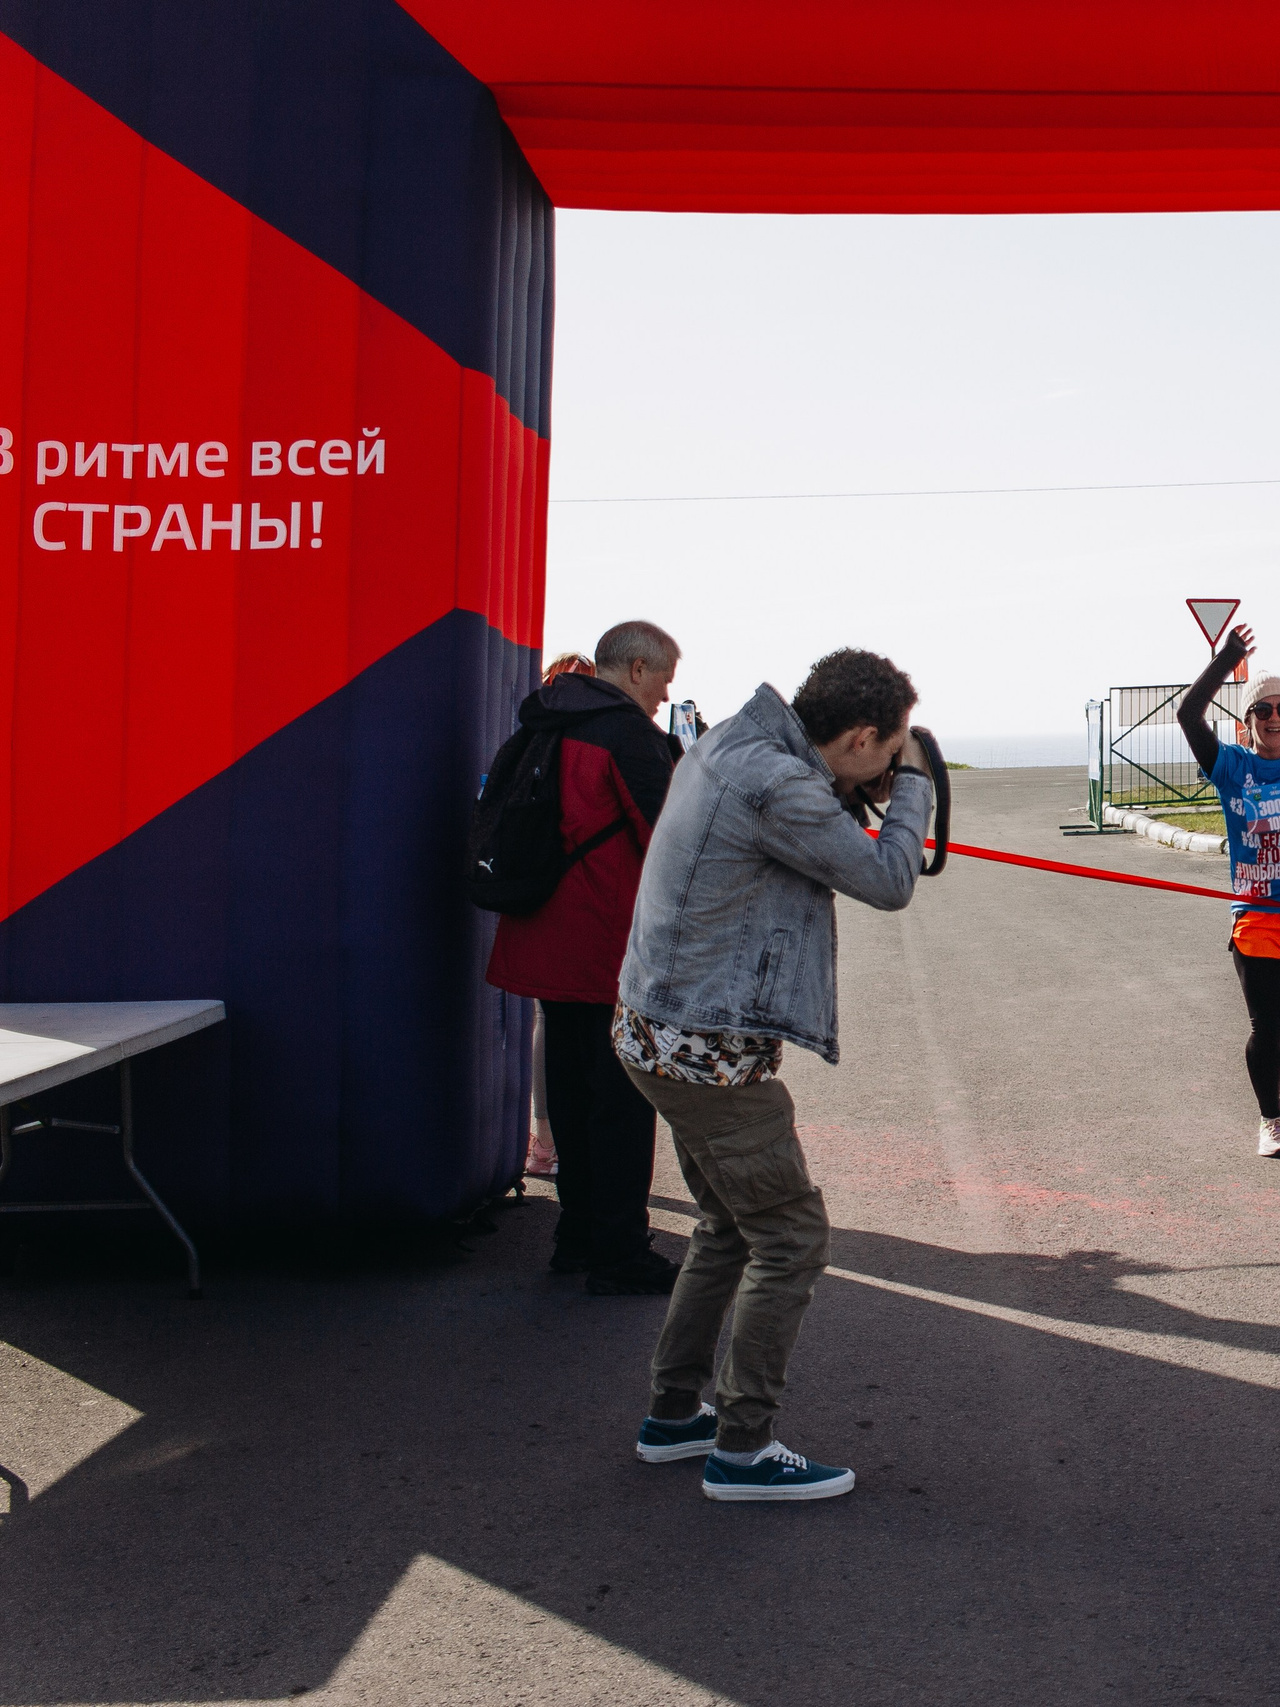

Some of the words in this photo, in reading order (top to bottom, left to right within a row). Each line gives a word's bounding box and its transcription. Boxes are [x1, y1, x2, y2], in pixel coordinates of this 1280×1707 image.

[36, 440, 229, 485] ритме
[250, 427, 387, 477] всей
[33, 501, 325, 552] СТРАНЫ!
